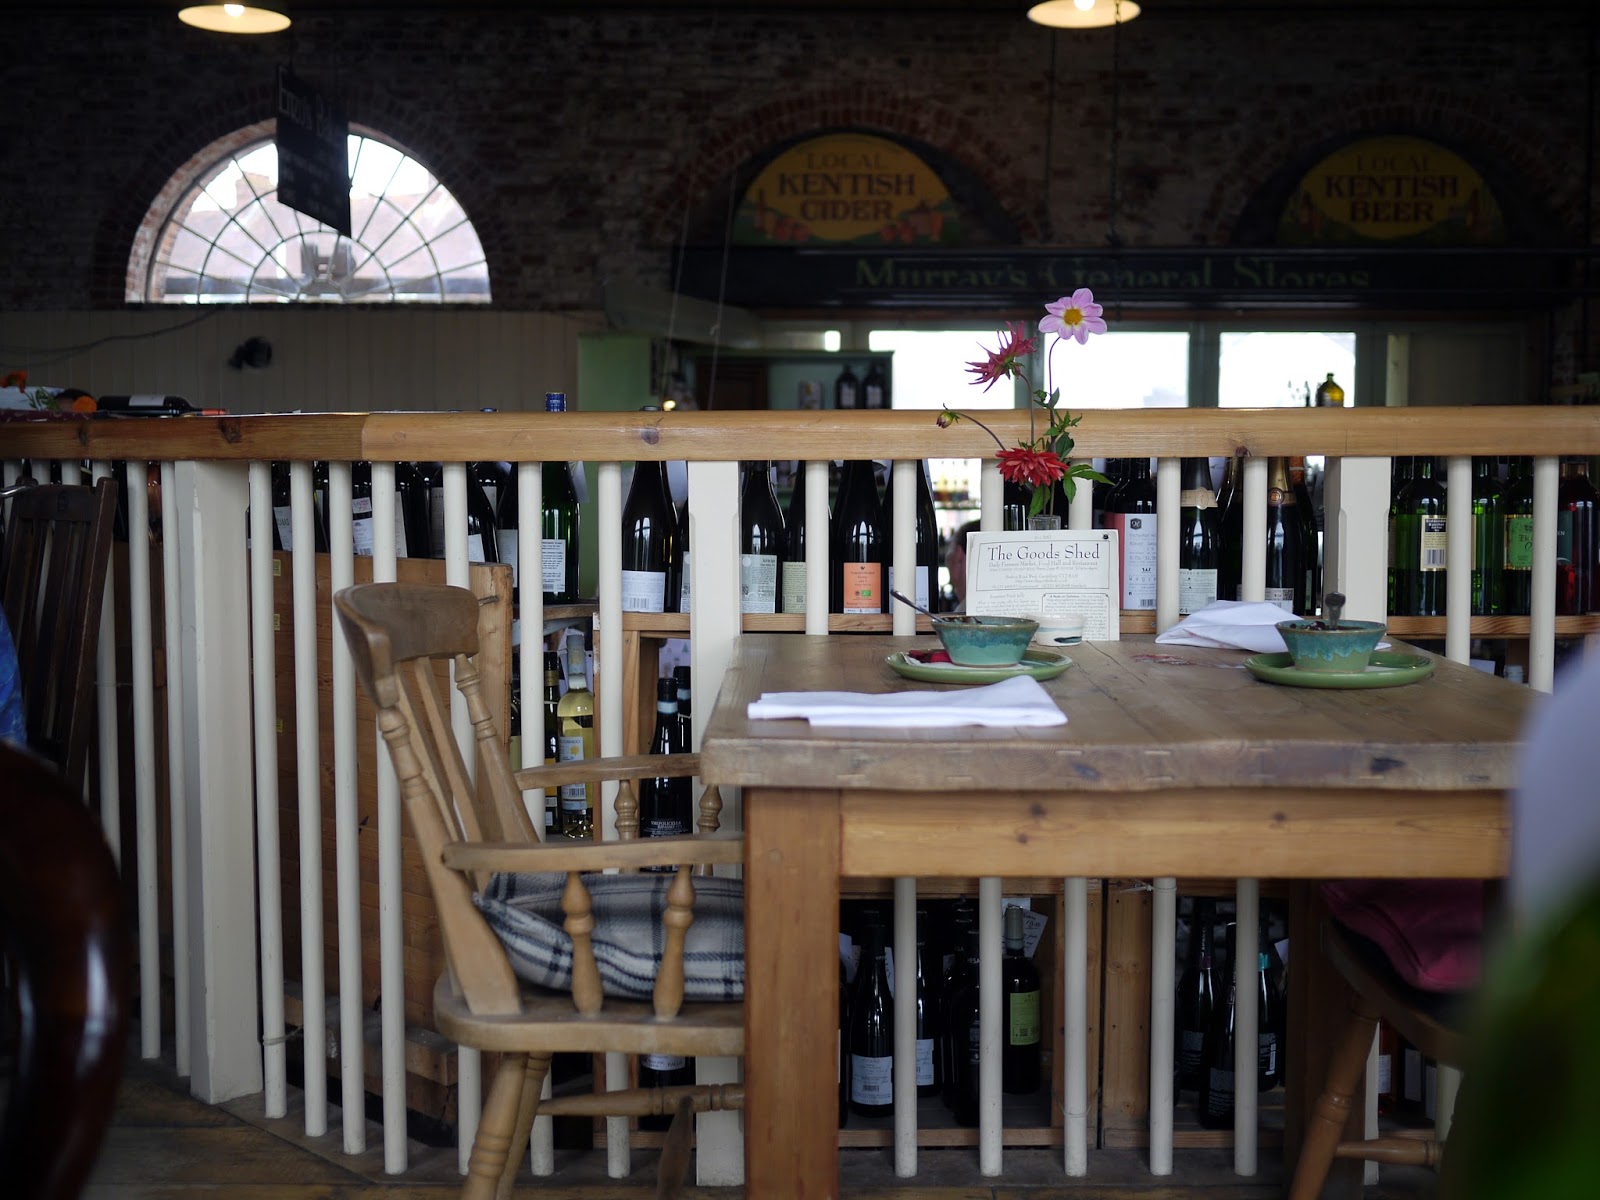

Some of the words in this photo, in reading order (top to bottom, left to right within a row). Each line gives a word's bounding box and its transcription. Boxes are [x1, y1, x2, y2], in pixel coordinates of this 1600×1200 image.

[807, 152, 889, 170] LOCAL
[1356, 153, 1432, 172] LOCAL
[777, 173, 916, 196] KENTISH
[1325, 175, 1458, 198] KENTISH
[799, 199, 895, 222] CIDER
[1350, 201, 1434, 222] BEER
[855, 256, 1029, 288] Murray's
[1233, 256, 1371, 288] Stores
[988, 544, 1013, 561] The
[1016, 543, 1060, 560] Goods
[1064, 543, 1101, 559] Shed
